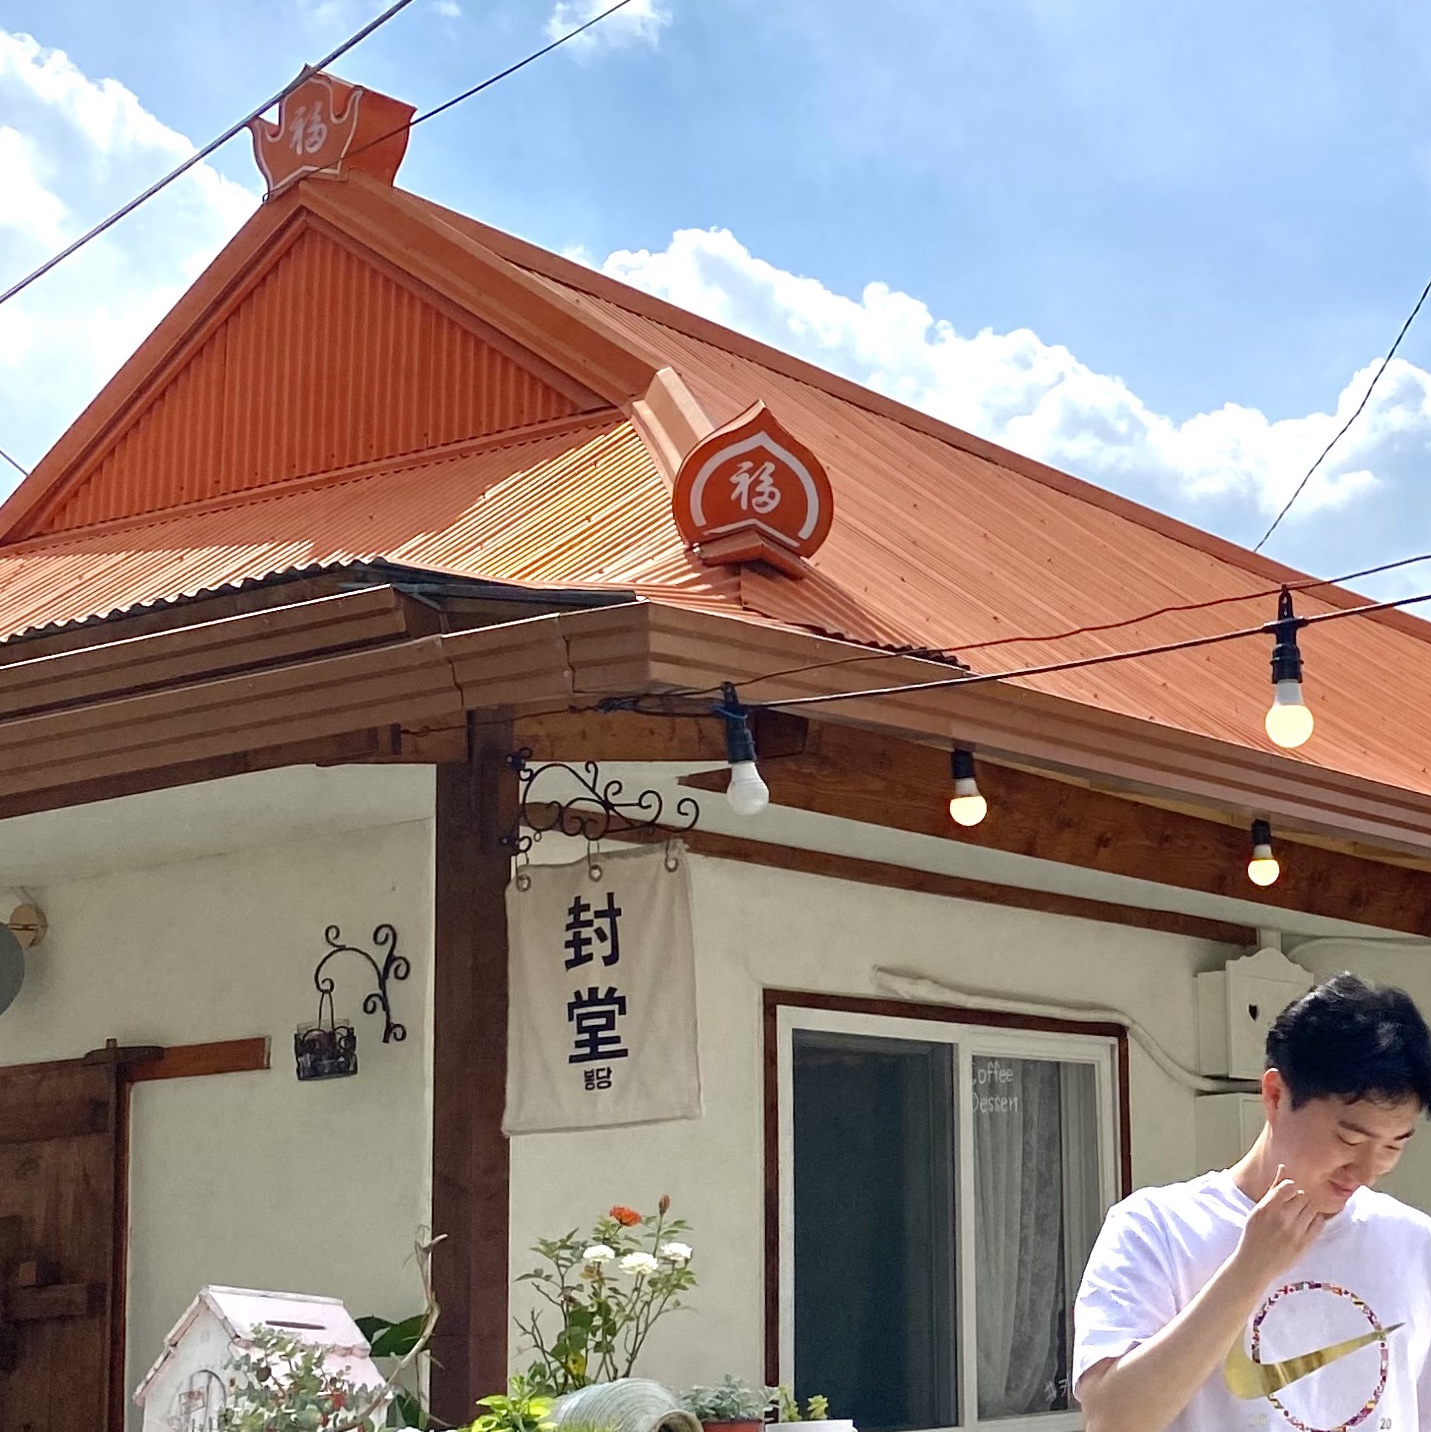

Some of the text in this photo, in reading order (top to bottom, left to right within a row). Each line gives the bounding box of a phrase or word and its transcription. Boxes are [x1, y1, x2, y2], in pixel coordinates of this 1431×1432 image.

[289, 102, 327, 155] 福
[729, 461, 781, 514] 福
[564, 892, 629, 1064] 封堂
[972, 1060, 1014, 1086] offee
